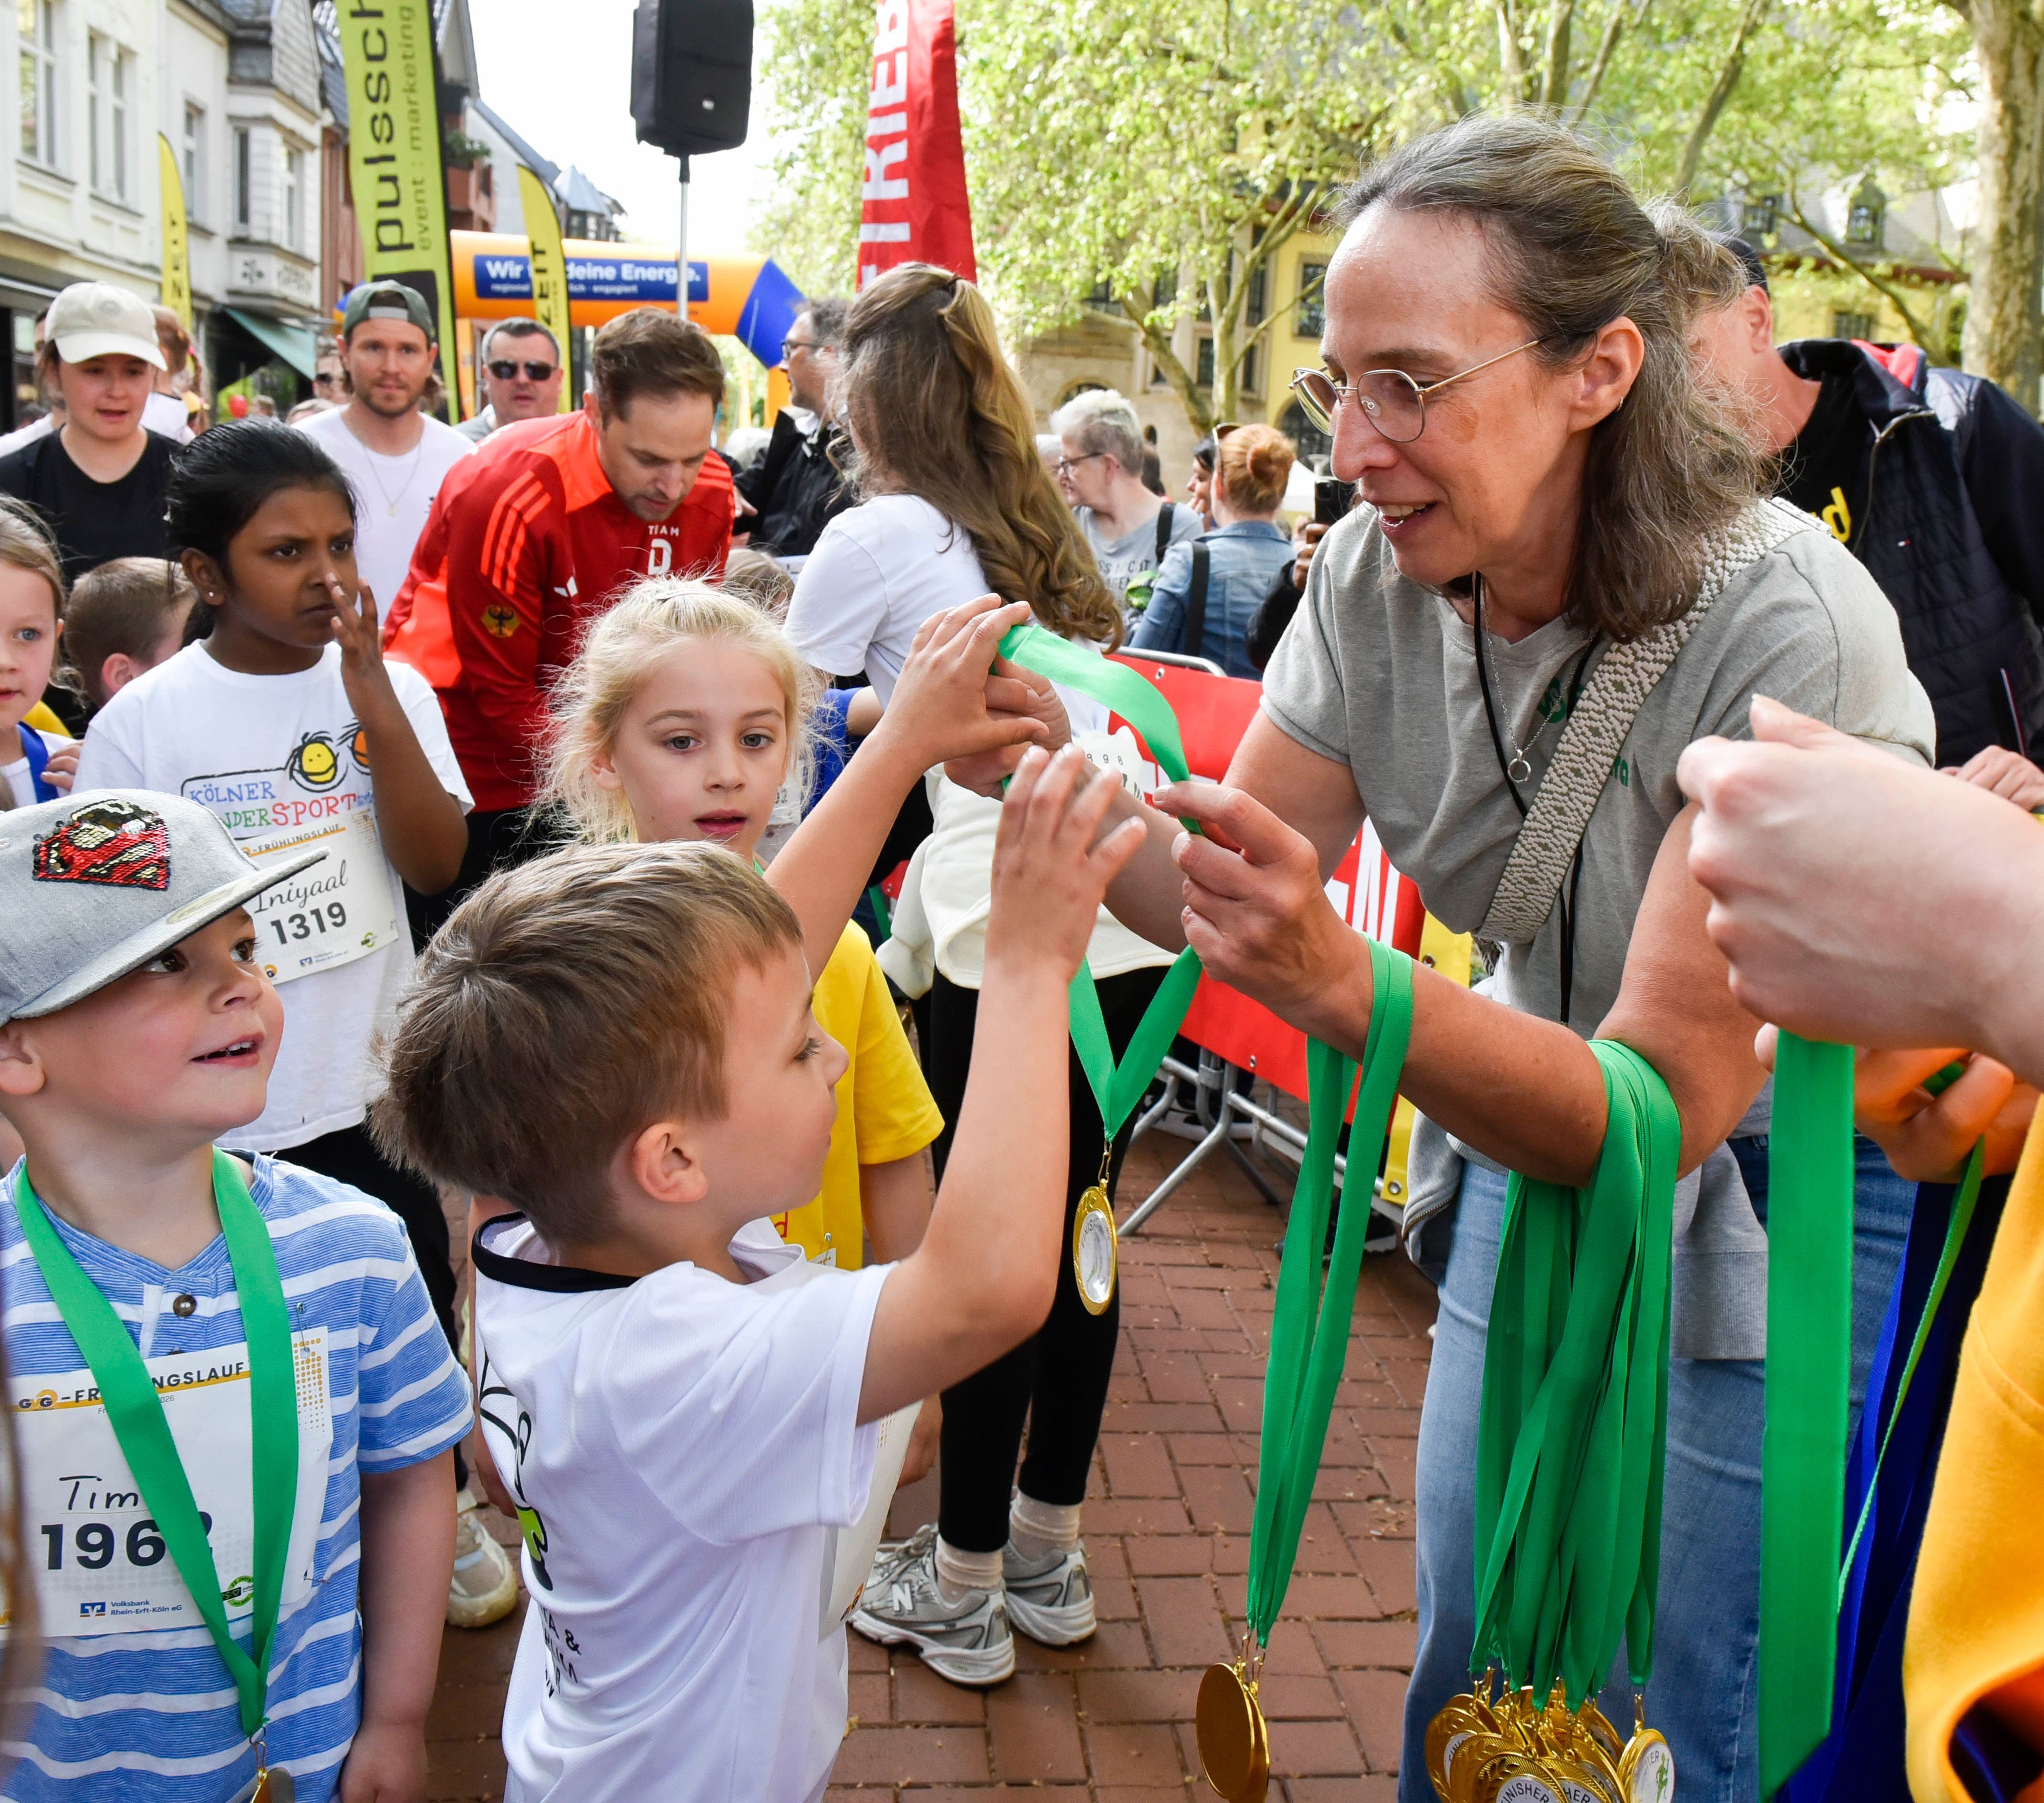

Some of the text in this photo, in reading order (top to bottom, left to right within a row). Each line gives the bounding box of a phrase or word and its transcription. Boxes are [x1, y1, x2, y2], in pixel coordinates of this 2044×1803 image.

[398, 6, 422, 151] marketing
[412, 177, 432, 251] event
[486, 260, 524, 280] Wir
[621, 263, 701, 285] Energe.
[189, 780, 276, 805] KÖLNER
[270, 902, 346, 945] 1319
[160, 1394, 175, 1403] 026
[59, 1475, 139, 1510] Tim
[41, 1511, 213, 1570] 196
[110, 1599, 151, 1607] Volksbank
[110, 1606, 170, 1616] Rhein-Erft-Köln
[1501, 1783, 1550, 1803] INISHER
